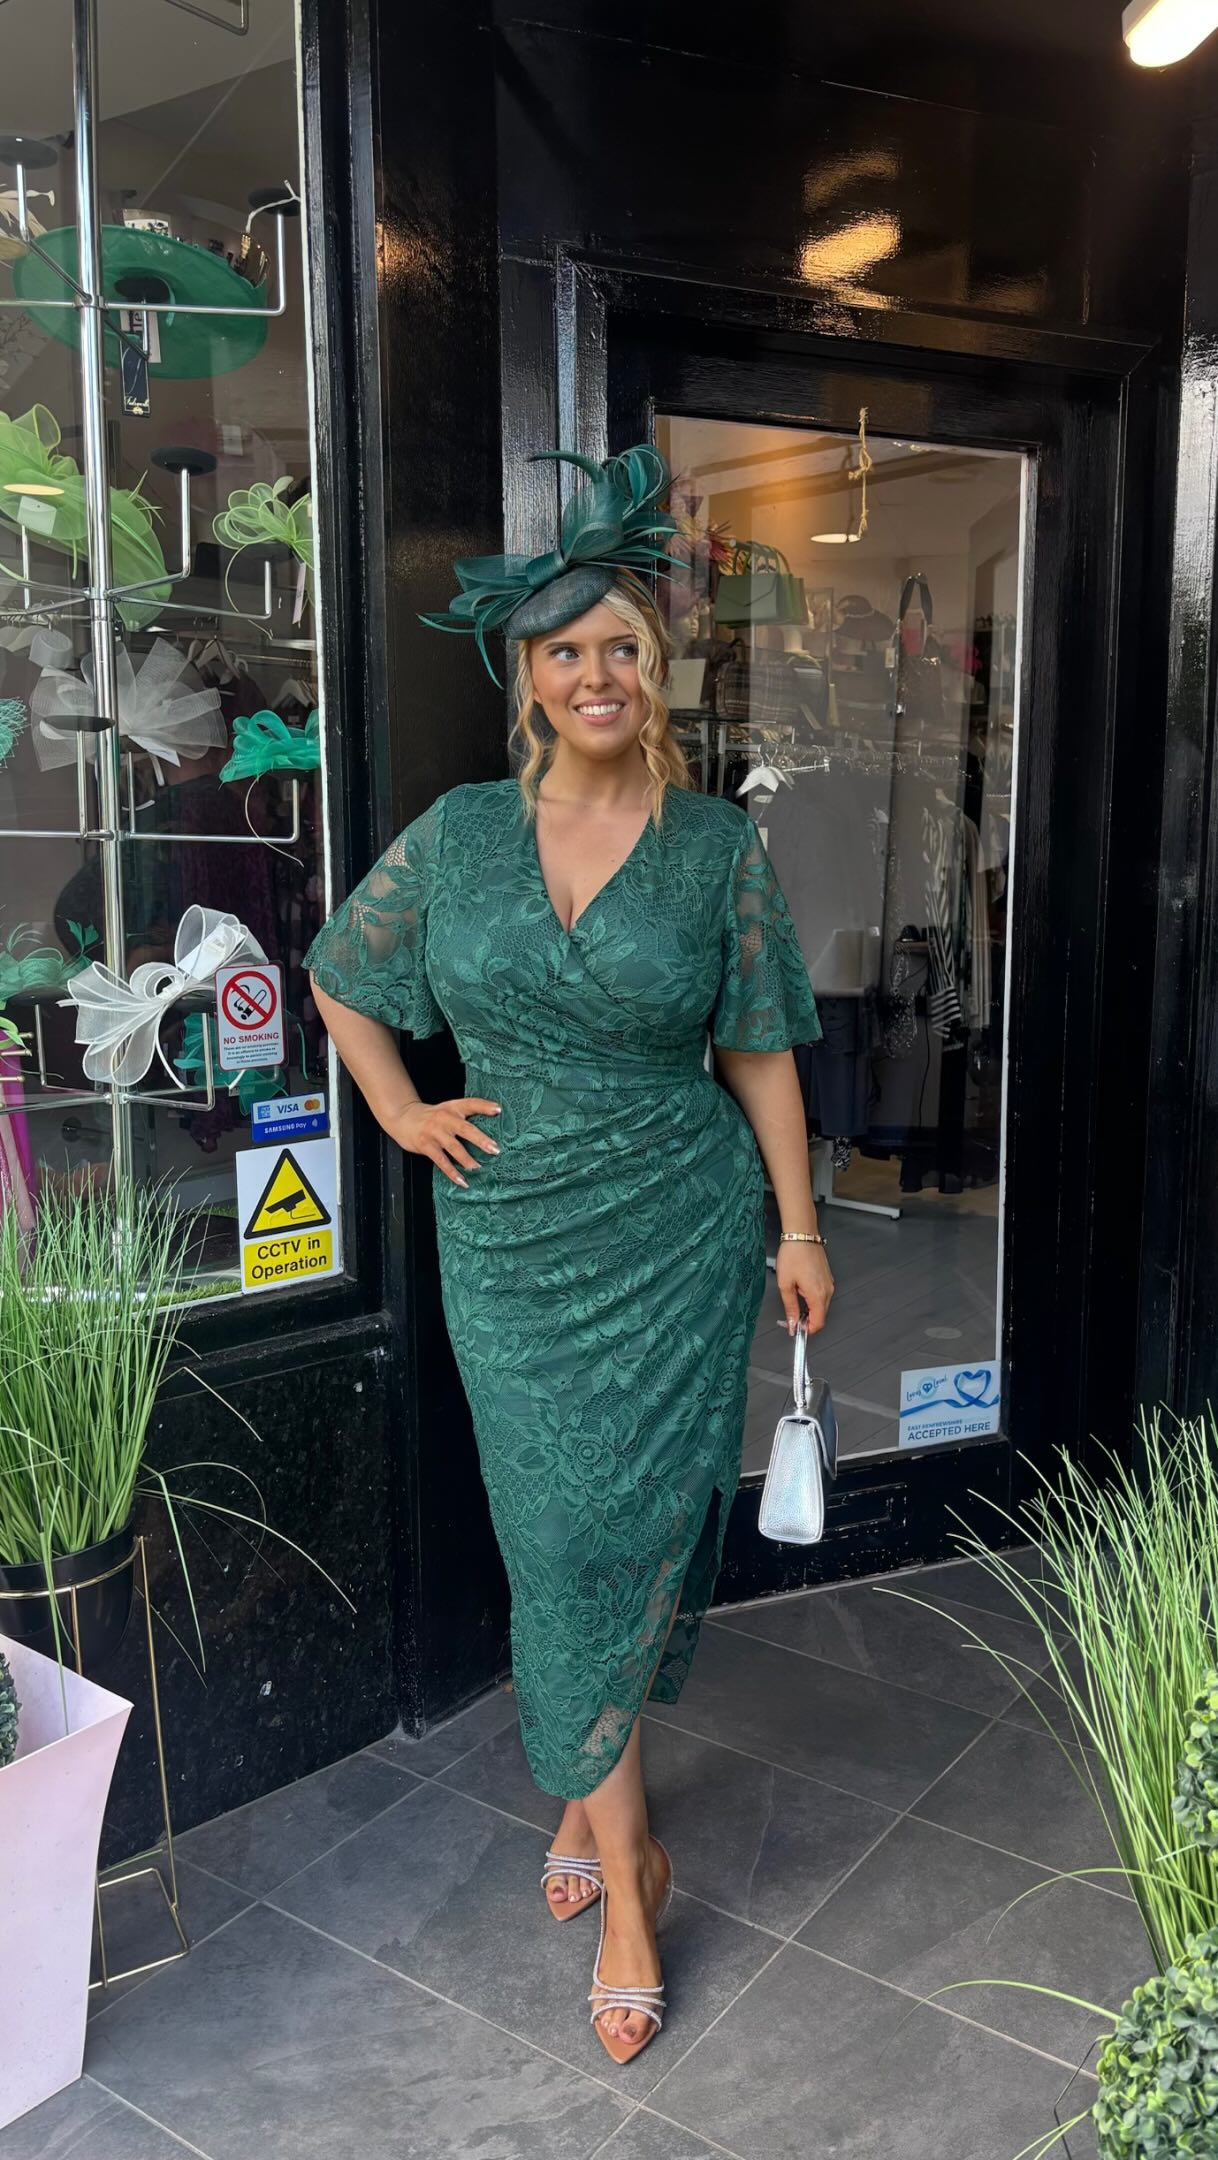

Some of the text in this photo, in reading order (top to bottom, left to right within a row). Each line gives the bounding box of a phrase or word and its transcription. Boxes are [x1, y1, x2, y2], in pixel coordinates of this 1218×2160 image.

[223, 1032, 279, 1045] NO SMOKING
[277, 1103, 299, 1114] VISA
[264, 1123, 295, 1134] SAMSUNG
[257, 1237, 321, 1260] CCTV in
[251, 1255, 327, 1280] Operation
[907, 1423, 920, 1431] EAST
[907, 1421, 991, 1441] ACCEPTED HERE
